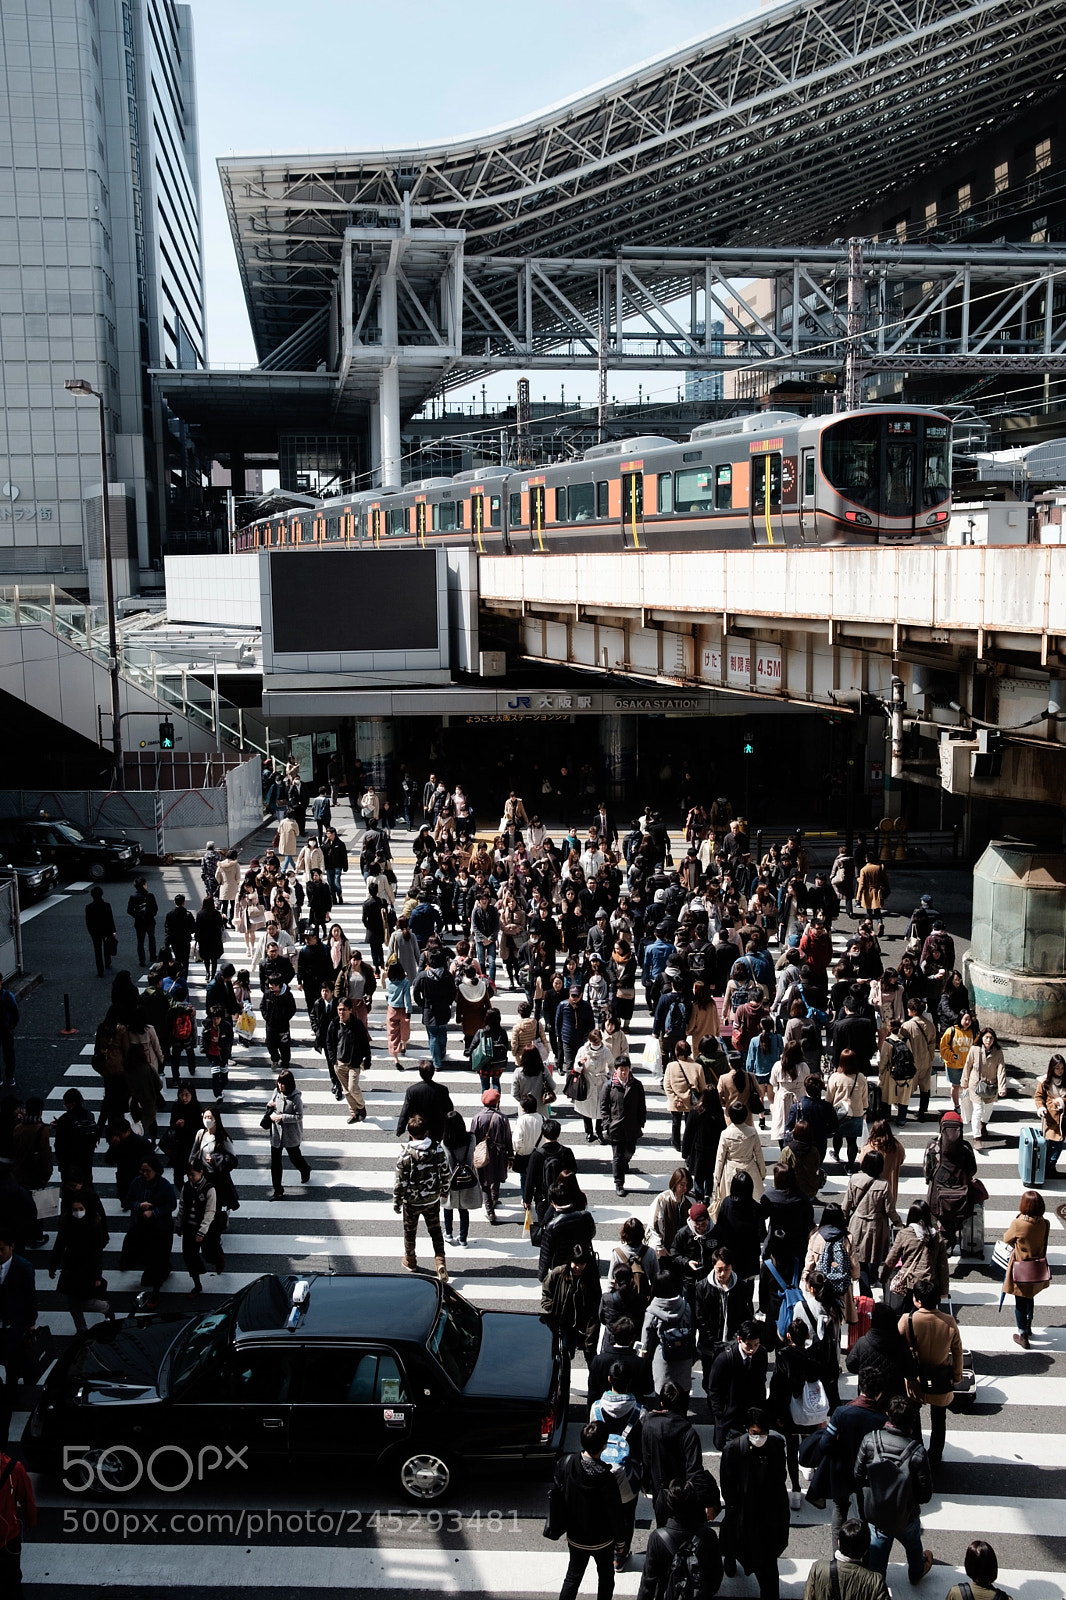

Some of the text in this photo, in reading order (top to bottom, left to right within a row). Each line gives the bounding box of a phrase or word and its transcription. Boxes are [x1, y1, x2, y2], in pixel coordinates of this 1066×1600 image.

[0, 506, 52, 521] トラン街
[757, 658, 781, 678] 4.5M
[508, 695, 592, 709] JR 大阪駅
[653, 698, 699, 710] STATION
